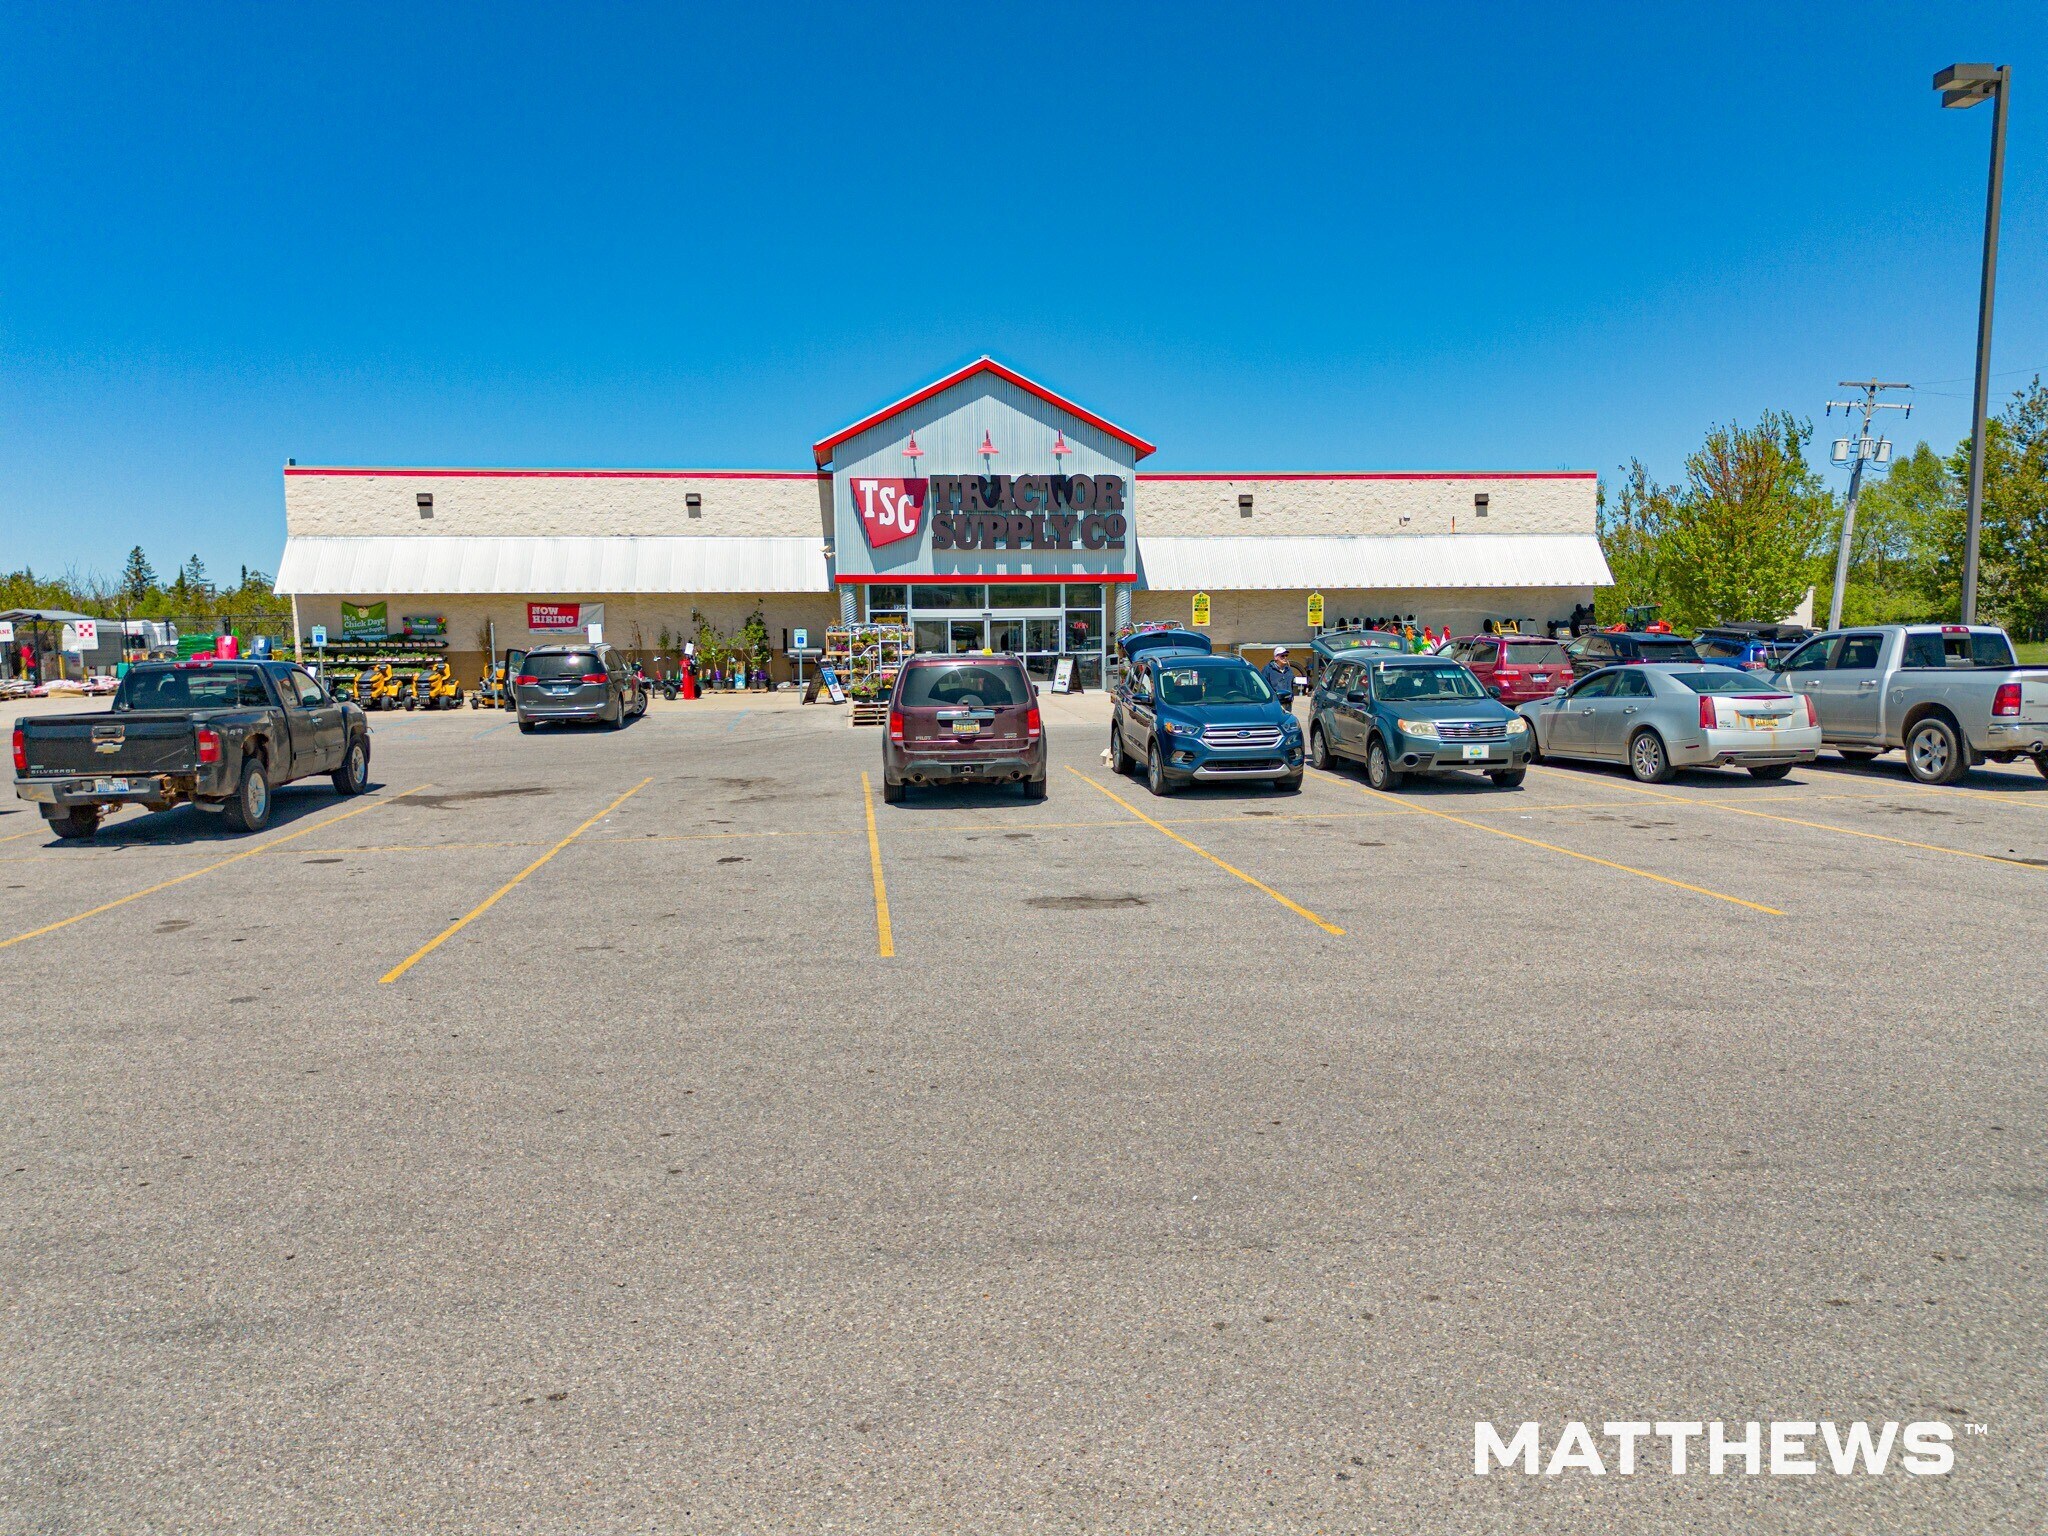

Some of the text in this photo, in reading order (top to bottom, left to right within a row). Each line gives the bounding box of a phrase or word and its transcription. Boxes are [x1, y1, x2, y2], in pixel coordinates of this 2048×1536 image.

[930, 474, 1125, 511] TRACTOR
[859, 480, 916, 534] TSC
[931, 513, 1079, 550] SUPPLY
[532, 606, 559, 615] NOW
[344, 618, 386, 628] Chick Days
[532, 615, 574, 624] HIRING
[1073, 621, 1089, 629] OPEN
